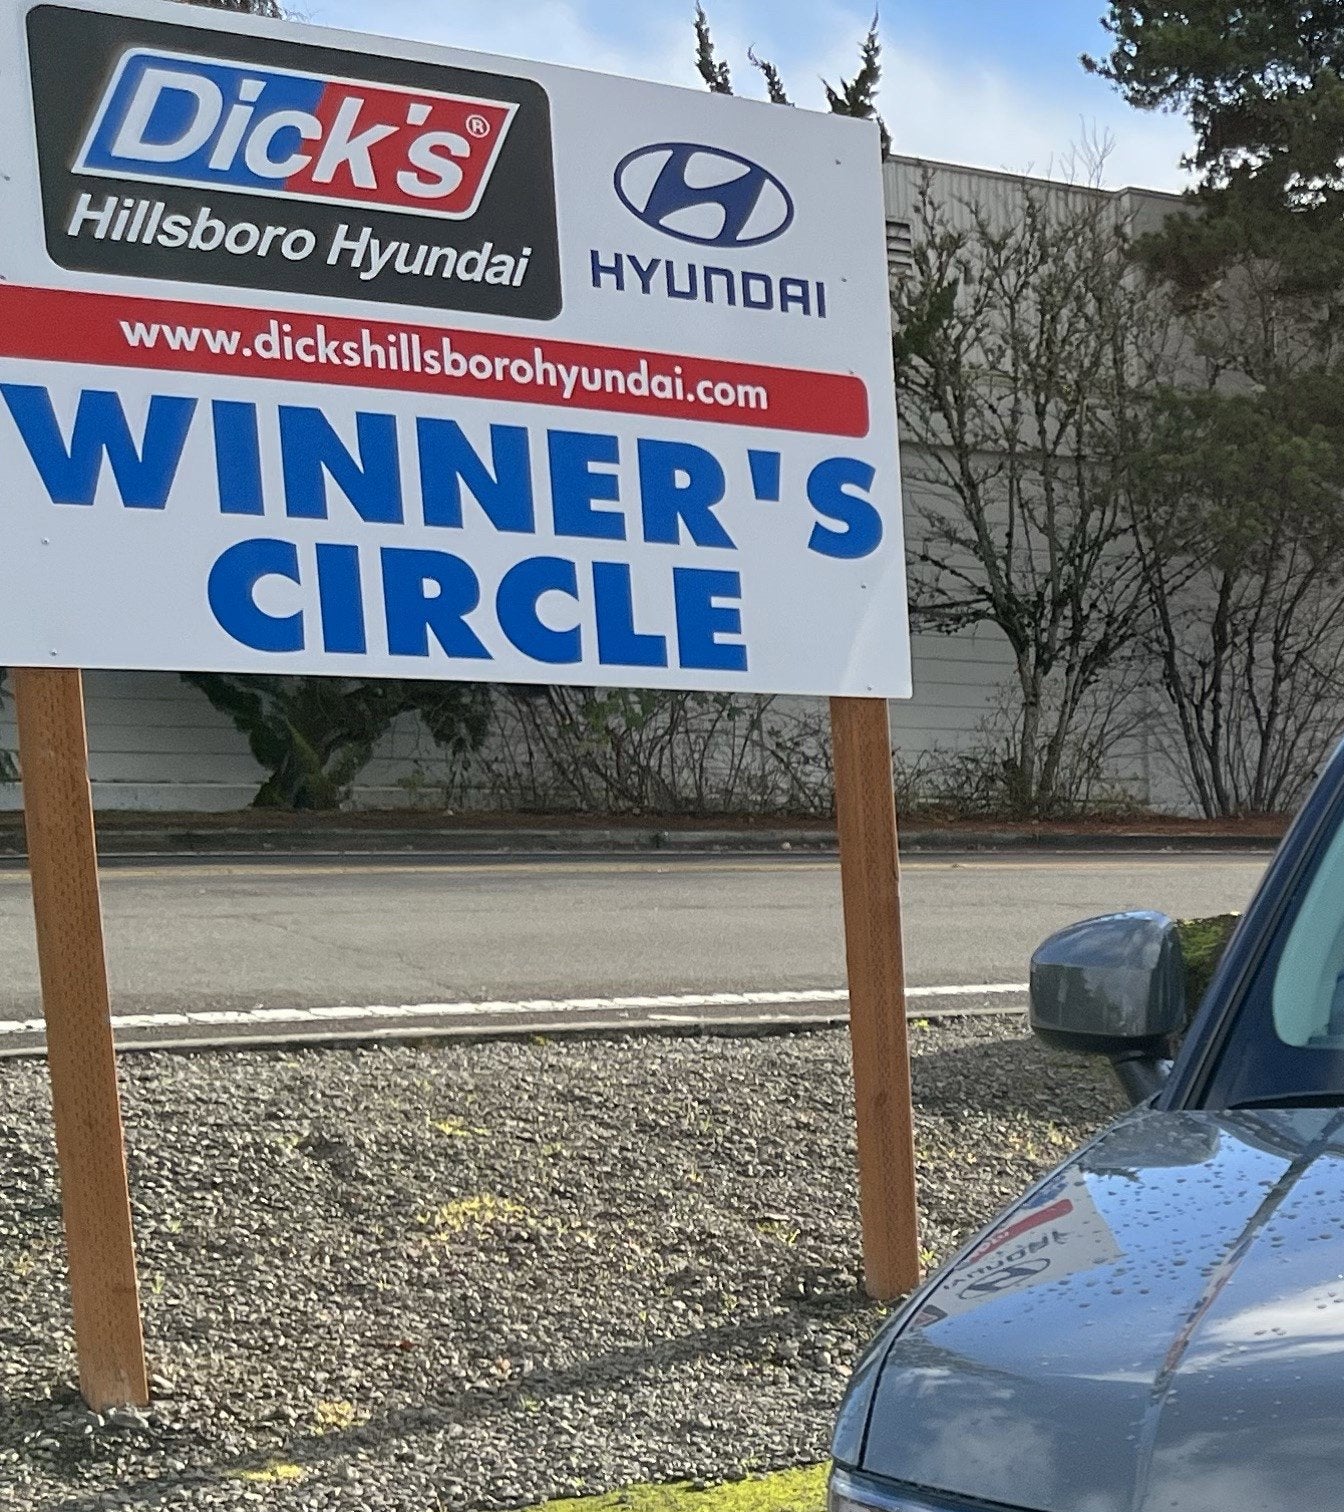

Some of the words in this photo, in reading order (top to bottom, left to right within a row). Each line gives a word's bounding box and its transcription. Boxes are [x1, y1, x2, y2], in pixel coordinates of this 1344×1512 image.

[67, 192, 316, 262] Hillsboro
[326, 223, 532, 288] Hyundai
[590, 249, 827, 319] HYUNDAI
[119, 318, 768, 410] www.dickshillsborohyundai.com
[0, 383, 883, 560] WINNER'S
[207, 538, 748, 672] CIRCLE
